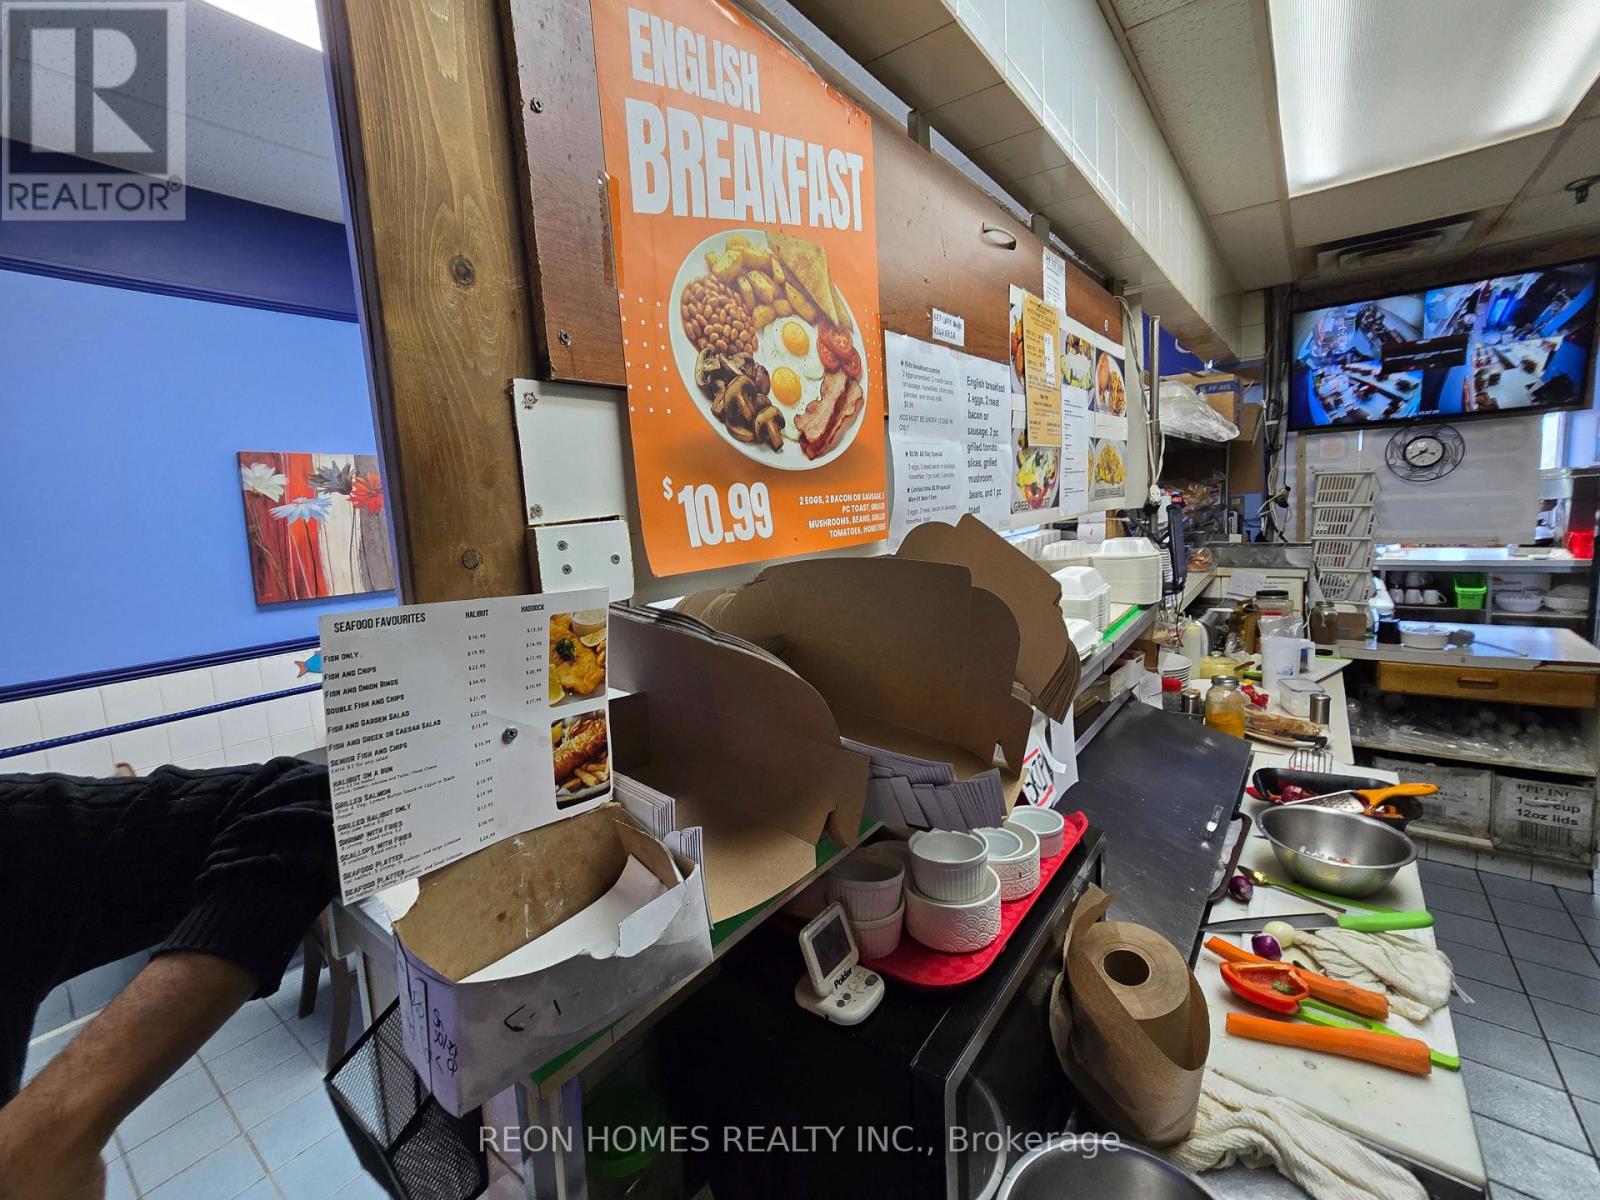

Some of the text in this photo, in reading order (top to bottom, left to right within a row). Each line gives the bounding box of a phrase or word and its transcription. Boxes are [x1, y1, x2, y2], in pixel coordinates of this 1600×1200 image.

[628, 8, 760, 114] ENGLISH
[625, 98, 863, 231] BREAKFAST
[967, 376, 985, 390] English
[967, 410, 982, 420] bacon
[967, 443, 982, 455] grilled
[983, 458, 997, 469] grilled
[799, 493, 861, 505] 2 EGGS, 2 BACON OR
[842, 505, 851, 513] PC
[852, 503, 871, 513] TOAST,
[808, 517, 852, 529] MUSHROOMS,
[829, 527, 863, 538] TOMATOES,
[465, 609, 489, 618] HALIBUT
[520, 604, 545, 613] HADDOCK
[333, 612, 426, 633] SEAFOOD FAVOURITES
[323, 652, 359, 663] FISH ONLY
[323, 666, 377, 681] FISH AND CHIPS
[325, 679, 399, 698] FISH AND ONION RINGS
[326, 694, 405, 716] DOUBLE FISH AND CHIPS
[327, 710, 410, 734] FISH AND GARDEN SALAD
[328, 719, 442, 752] FISH AND GREEK OR CAESAR SALAD
[330, 742, 408, 767] SENIOR FISH AND CHIPS
[333, 774, 361, 788] HALIBUT
[363, 771, 372, 780] ON
[374, 769, 379, 777] A
[380, 766, 393, 775] BUN
[334, 788, 391, 810] GRILLED SALMON
[337, 802, 411, 832] GRILLED HALIBUT ONLY
[1516, 808, 1578, 826] 12oz lids
[1552, 803, 1581, 815] cup
[366, 826, 383, 838] WITH
[384, 820, 403, 831] FRIES
[340, 844, 375, 863] SCALLOPS
[377, 838, 393, 849] WITH
[394, 832, 412, 843] FRIES
[342, 864, 374, 881] SEAFOOD
[375, 853, 404, 868] PLATTER
[345, 880, 376, 897] SEAFOOD
[377, 869, 404, 885] PLATTER
